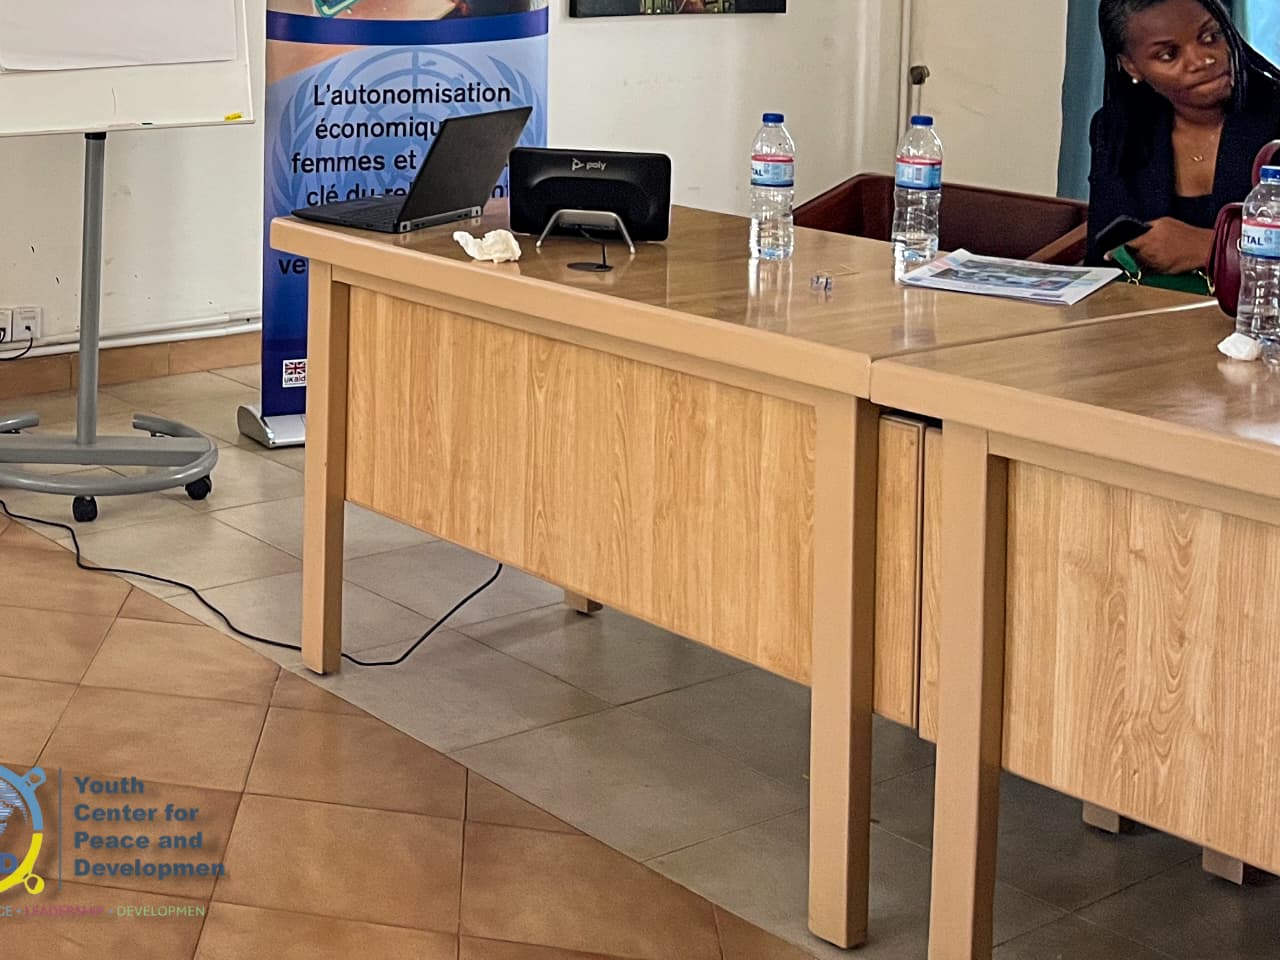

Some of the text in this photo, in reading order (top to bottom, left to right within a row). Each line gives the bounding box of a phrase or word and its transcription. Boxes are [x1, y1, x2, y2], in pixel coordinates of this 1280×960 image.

[315, 116, 443, 141] économiqu
[291, 150, 417, 174] femmes et
[586, 161, 607, 171] poly
[306, 184, 339, 206] clé
[278, 257, 307, 274] ve
